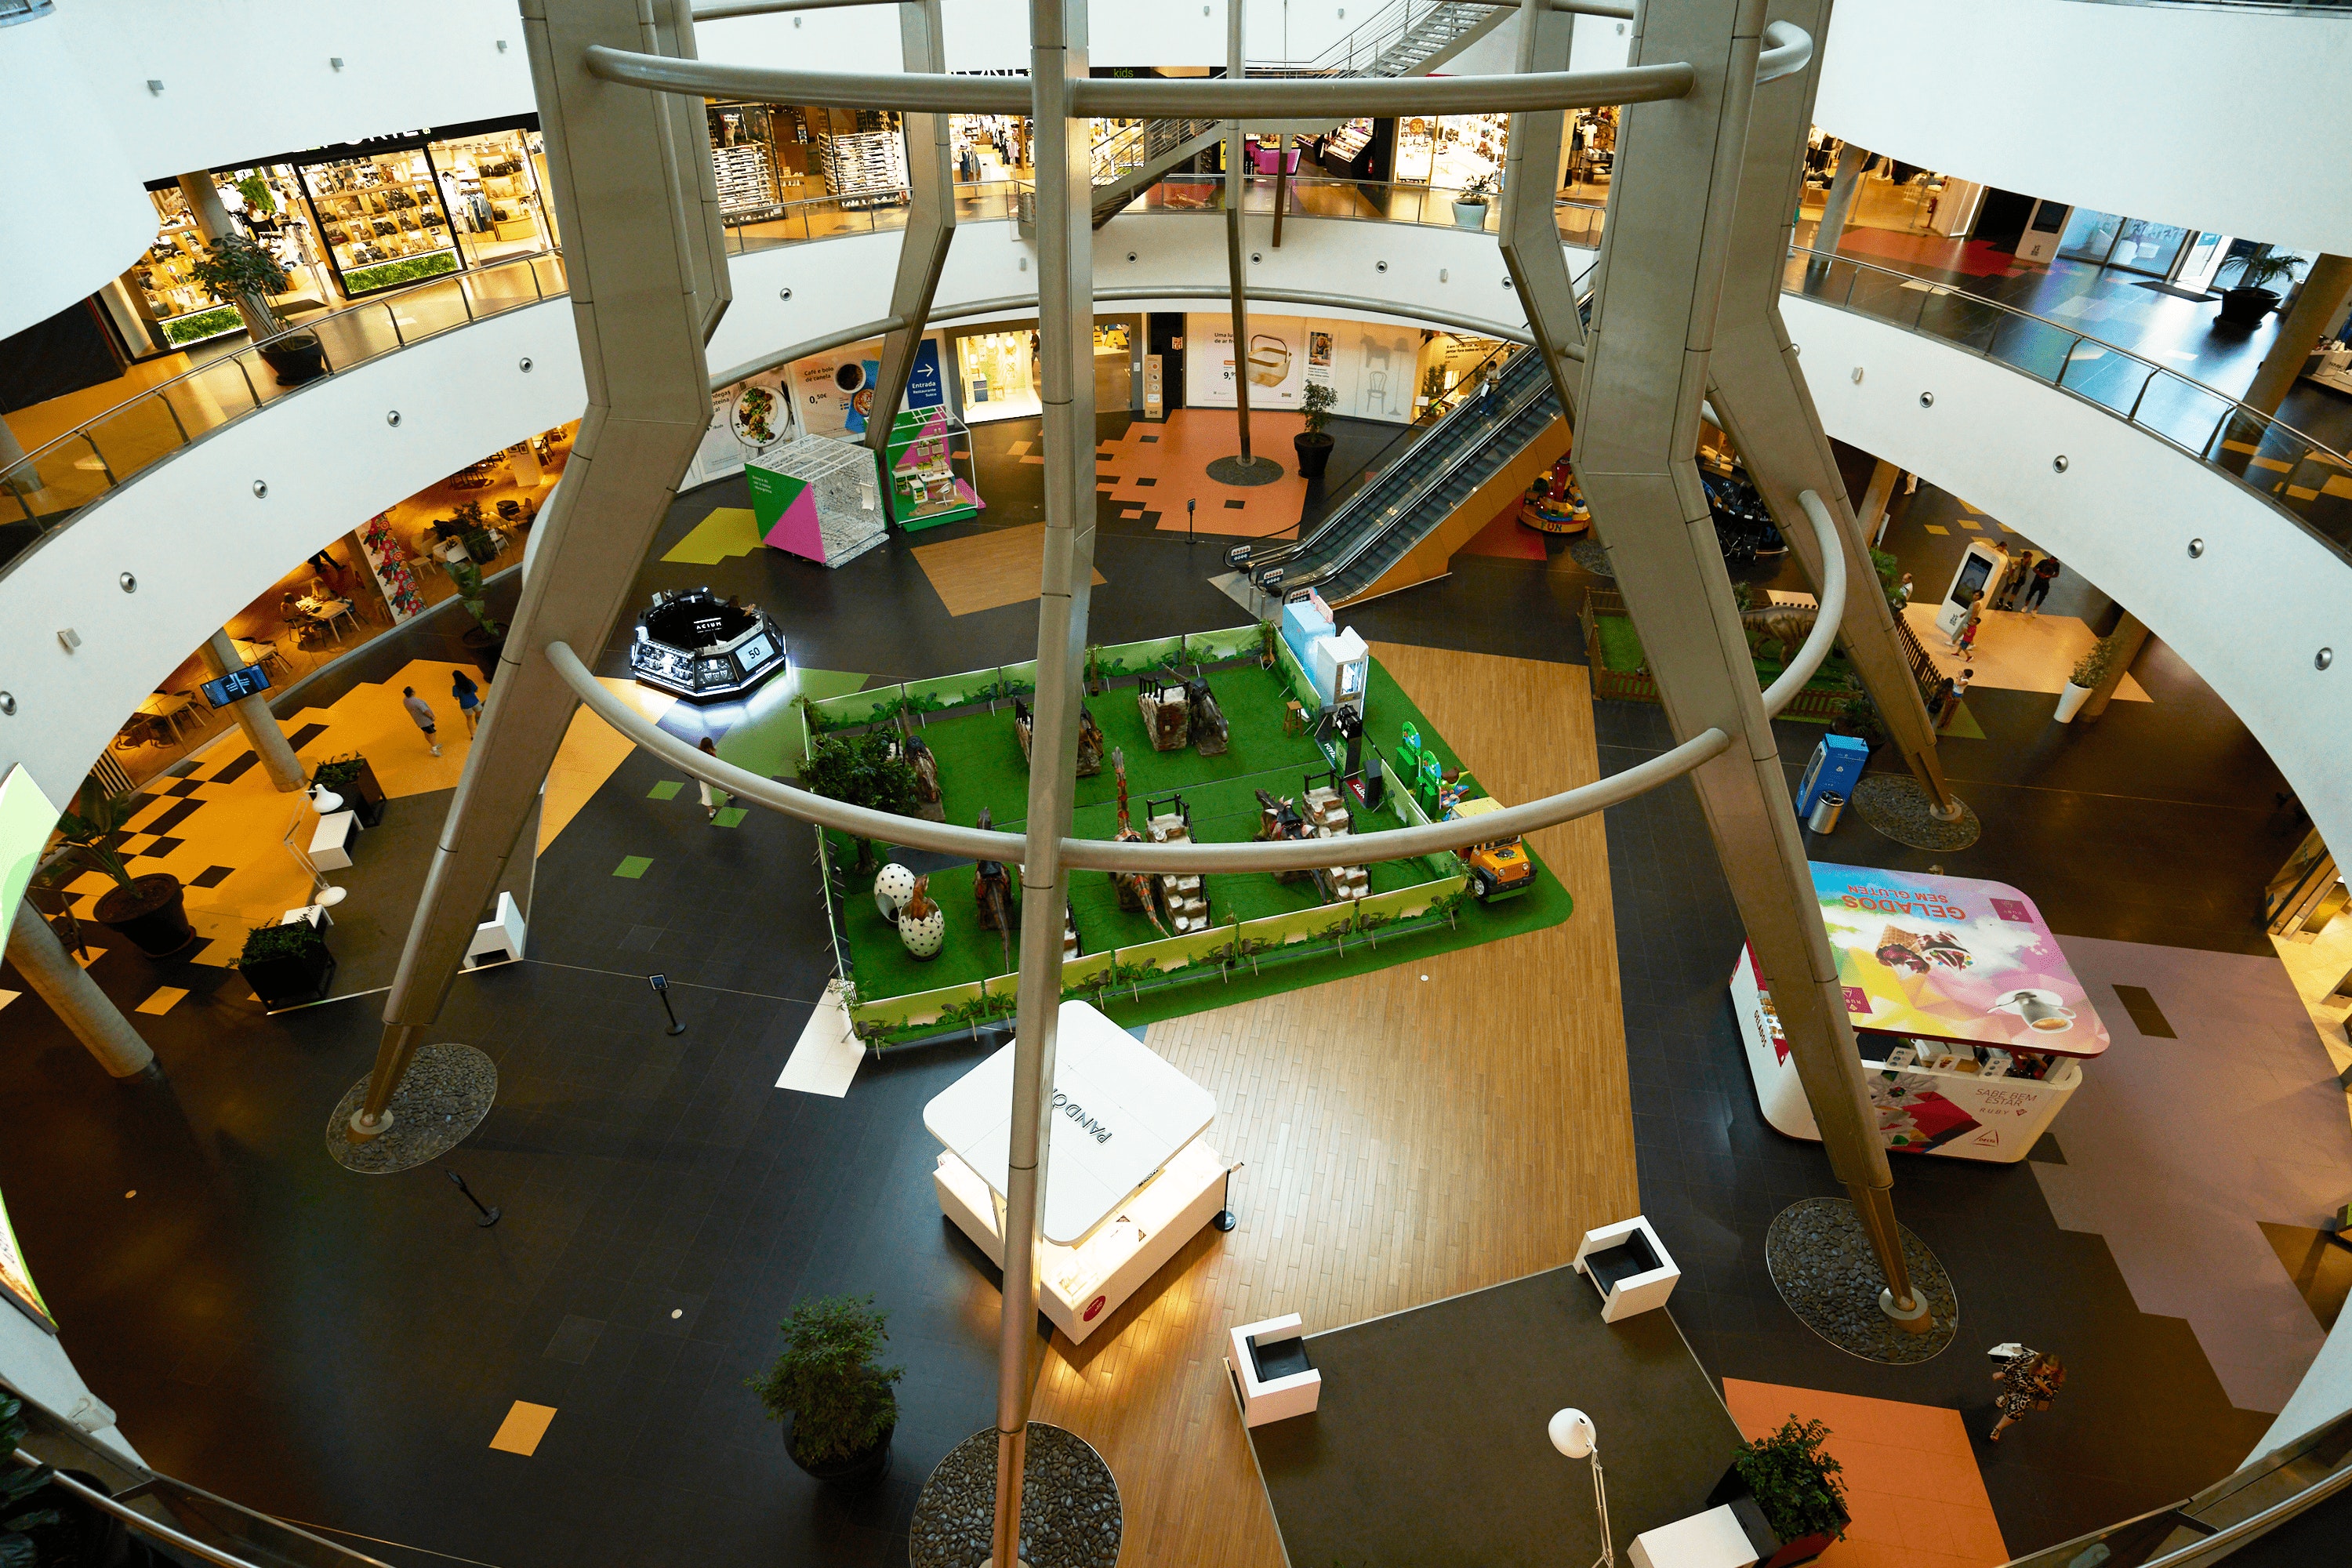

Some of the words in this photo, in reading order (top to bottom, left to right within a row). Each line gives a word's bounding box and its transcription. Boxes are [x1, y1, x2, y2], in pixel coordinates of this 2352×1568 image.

[1113, 67, 1134, 78] kids
[1541, 522, 1563, 532] FUN
[748, 647, 760, 659] 50
[1847, 884, 1911, 899] GLÚTEN
[1915, 892, 1949, 904] SEM
[1841, 895, 1966, 920] GELADOS
[1754, 1010, 1768, 1048] GELADOS
[1976, 1088, 2007, 1098] SABE
[2009, 1092, 2038, 1102] BEM
[1985, 1097, 2023, 1107] ESTAR
